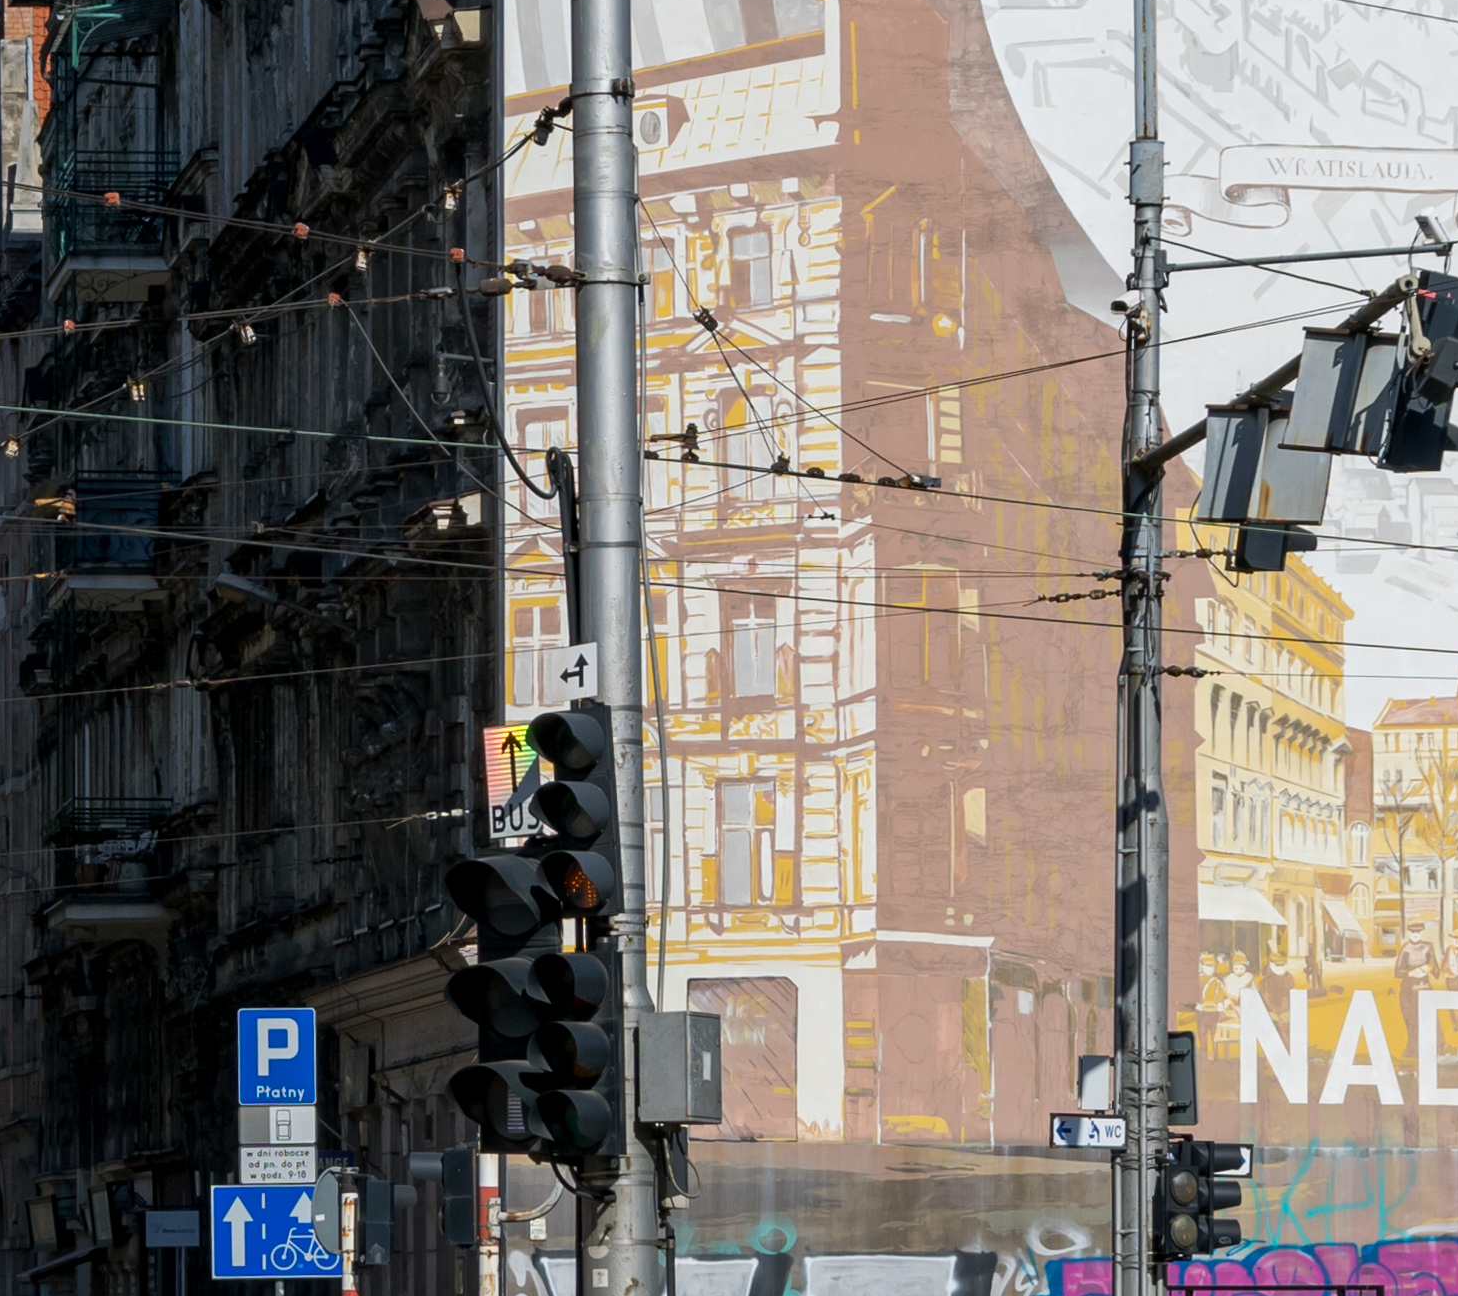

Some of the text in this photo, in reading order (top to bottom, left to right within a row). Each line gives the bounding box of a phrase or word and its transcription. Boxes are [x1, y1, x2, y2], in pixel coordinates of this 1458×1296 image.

[256, 1018, 299, 1076] P
[256, 1086, 305, 1101] Płatny
[1105, 1125, 1122, 1138] WC
[257, 1149, 272, 1157] dni
[274, 1149, 310, 1158] robocze
[263, 1161, 278, 1170] pn.
[296, 1161, 308, 1170] pt.
[260, 1171, 284, 1181] godz.
[288, 1170, 307, 1179] 9-18
